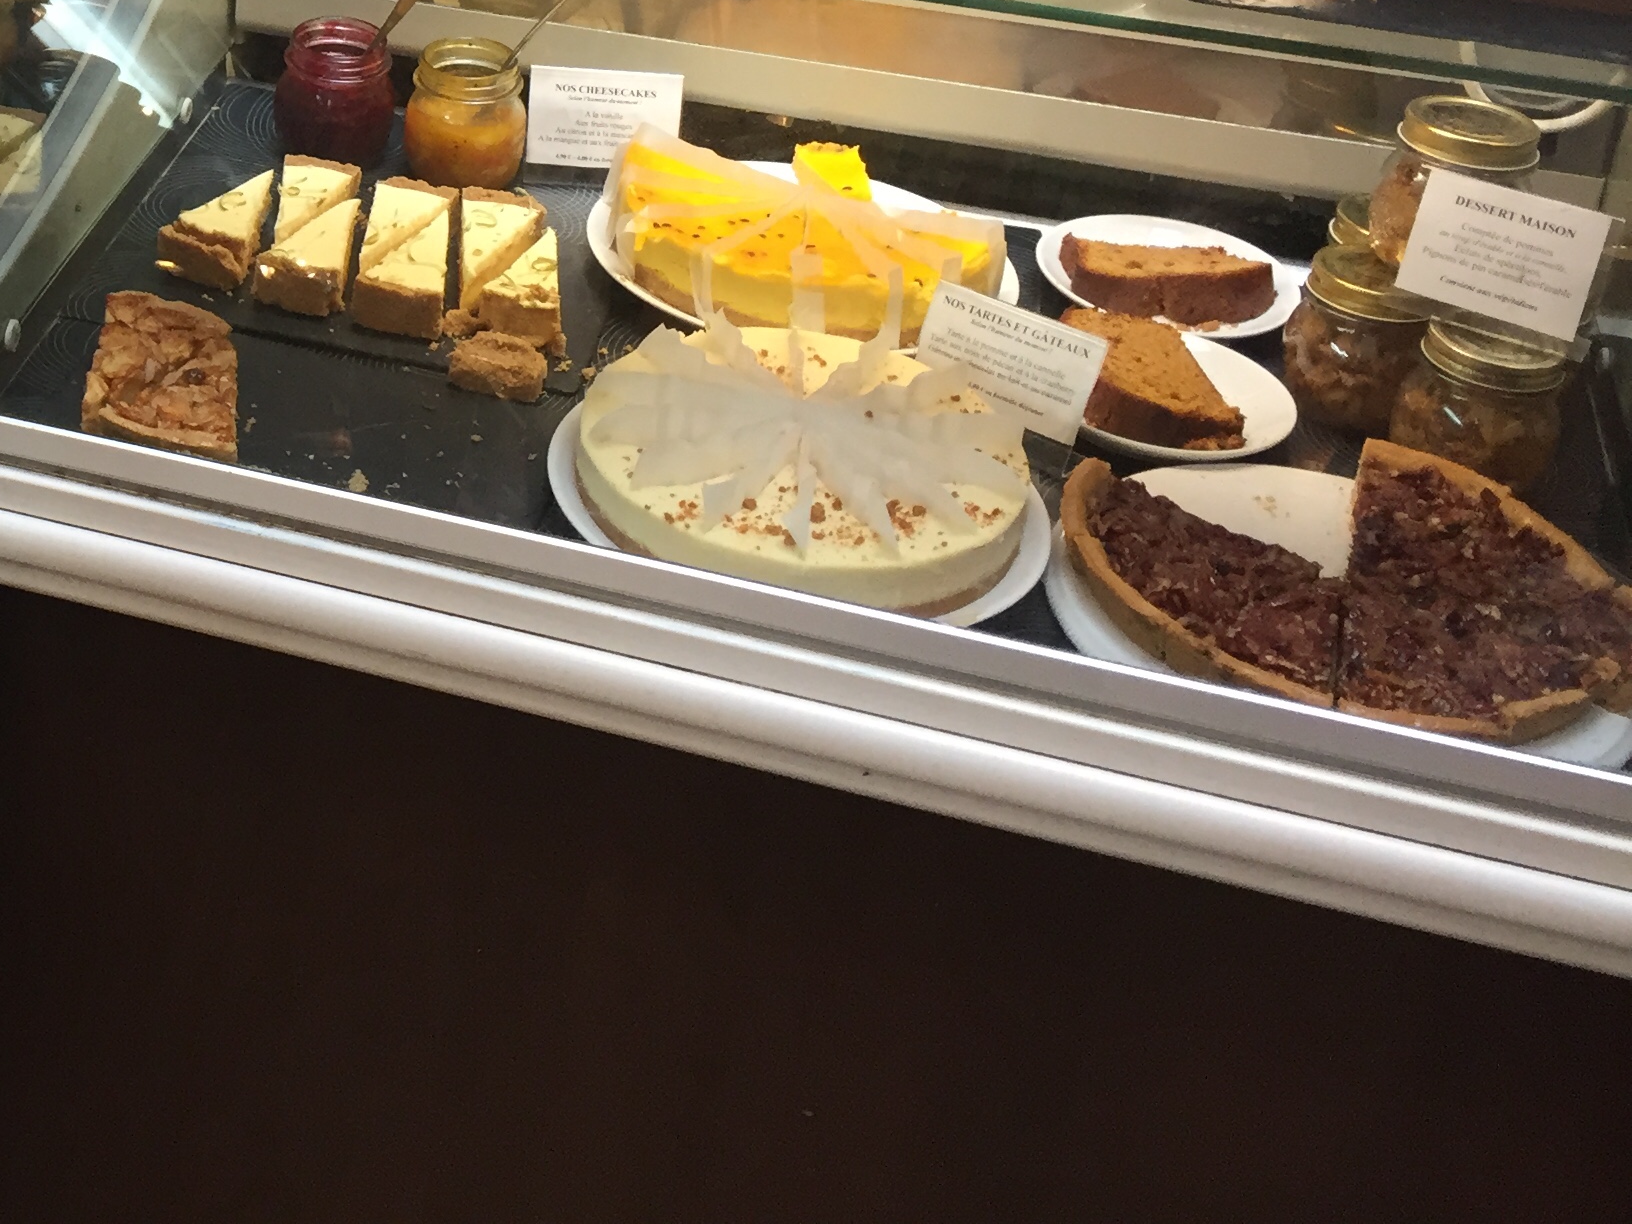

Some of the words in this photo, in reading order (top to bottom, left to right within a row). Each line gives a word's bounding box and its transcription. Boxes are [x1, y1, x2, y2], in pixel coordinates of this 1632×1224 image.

[555, 83, 576, 92] NOS
[578, 85, 657, 98] CHEESECAKES
[1455, 195, 1515, 221] DESSERT
[1519, 215, 1575, 239] MAISON
[943, 296, 966, 311] NOS
[968, 305, 1012, 328] TARTES
[1014, 322, 1029, 335] ET
[1031, 327, 1091, 358] GÂTEAUX
[947, 328, 964, 339] Tarte
